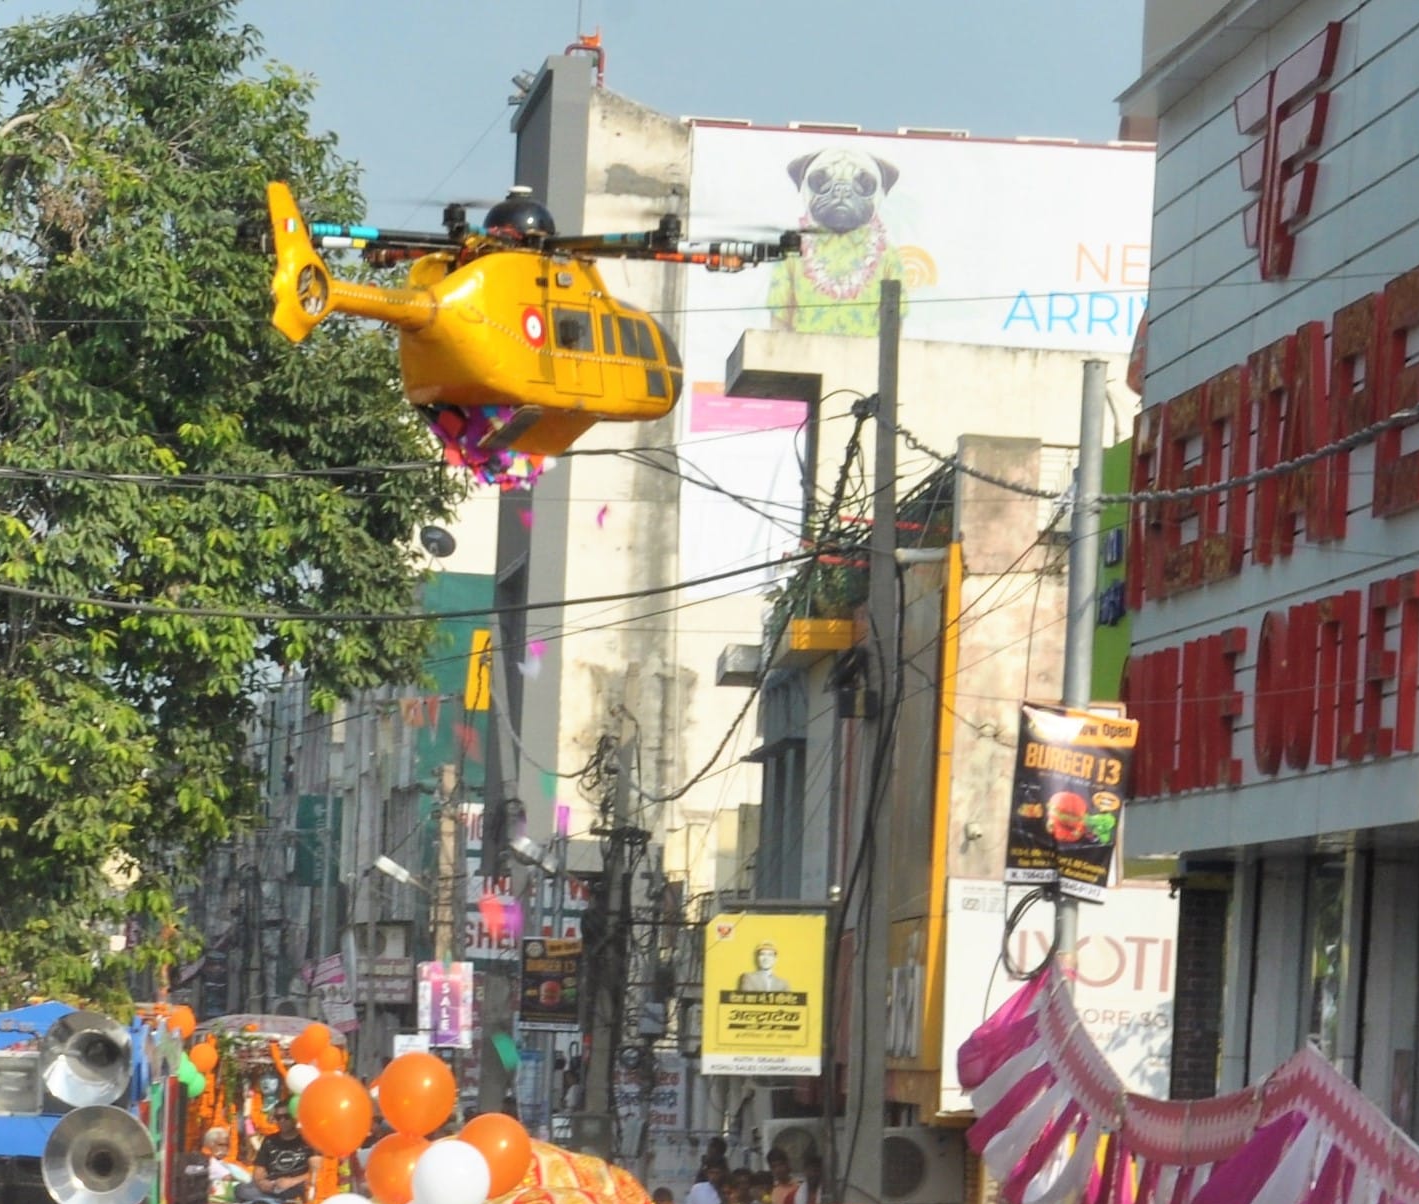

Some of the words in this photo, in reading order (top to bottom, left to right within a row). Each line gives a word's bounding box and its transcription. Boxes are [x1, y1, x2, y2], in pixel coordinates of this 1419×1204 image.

[1102, 722, 1133, 739] Open
[1024, 742, 1096, 780] BURGER
[1096, 757, 1123, 786] 13
[440, 982, 452, 1032] SALE
